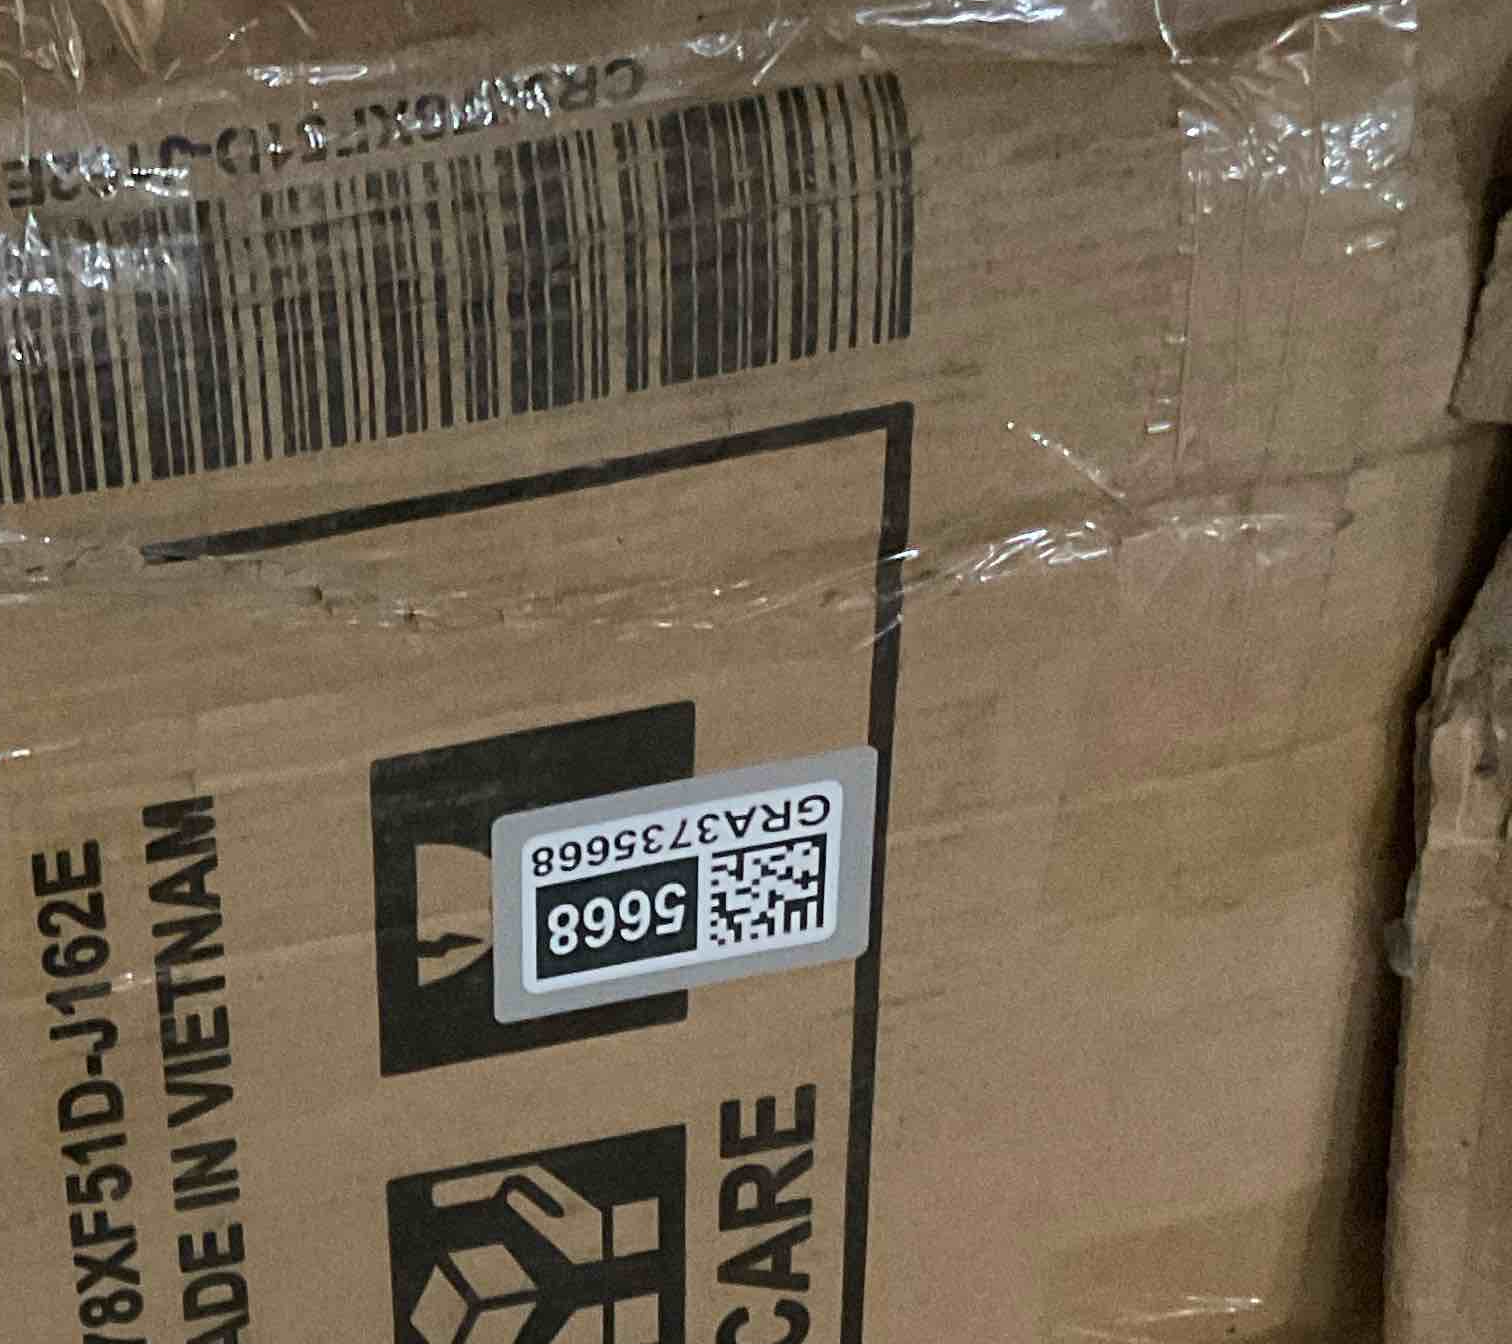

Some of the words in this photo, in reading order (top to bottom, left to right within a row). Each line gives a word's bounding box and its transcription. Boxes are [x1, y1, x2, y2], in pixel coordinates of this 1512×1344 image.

[531, 793, 831, 878] GRA3735668
[547, 881, 688, 956] 5668
[141, 794, 234, 1127] VIETNAM
[170, 1137, 241, 1210] IN
